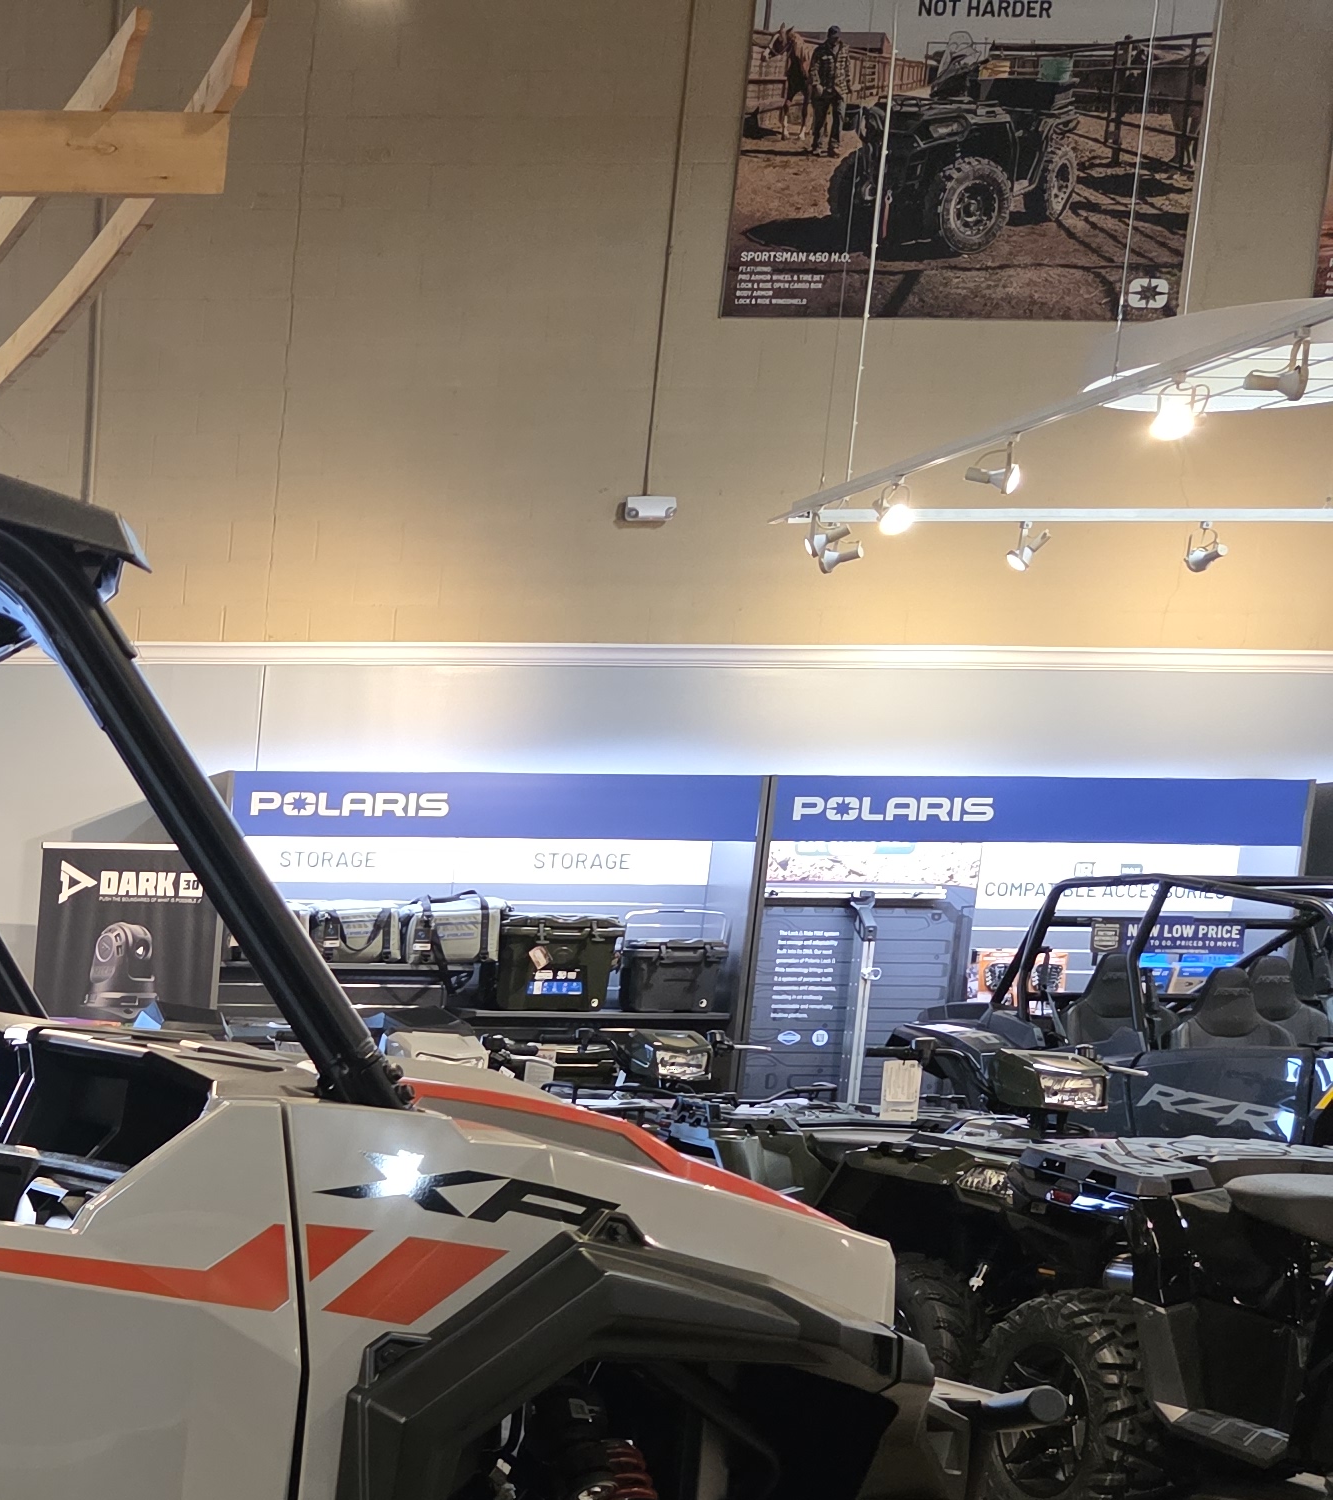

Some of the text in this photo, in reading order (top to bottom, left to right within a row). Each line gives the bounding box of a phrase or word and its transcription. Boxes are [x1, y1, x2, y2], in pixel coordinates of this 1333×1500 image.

[918, 0, 1053, 19] NOT HARDER
[740, 251, 806, 263] SPORTSMAN
[808, 252, 829, 263] 450
[249, 791, 450, 818] POLARIS
[792, 796, 995, 822] POLARIS
[279, 850, 377, 869] STORAGE
[534, 852, 631, 871] STORAGE
[99, 870, 176, 897] DARK
[984, 882, 1095, 898] COMPABLE
[1127, 923, 1242, 939] NW LOW PRICE
[1136, 1083, 1284, 1136] RZR
